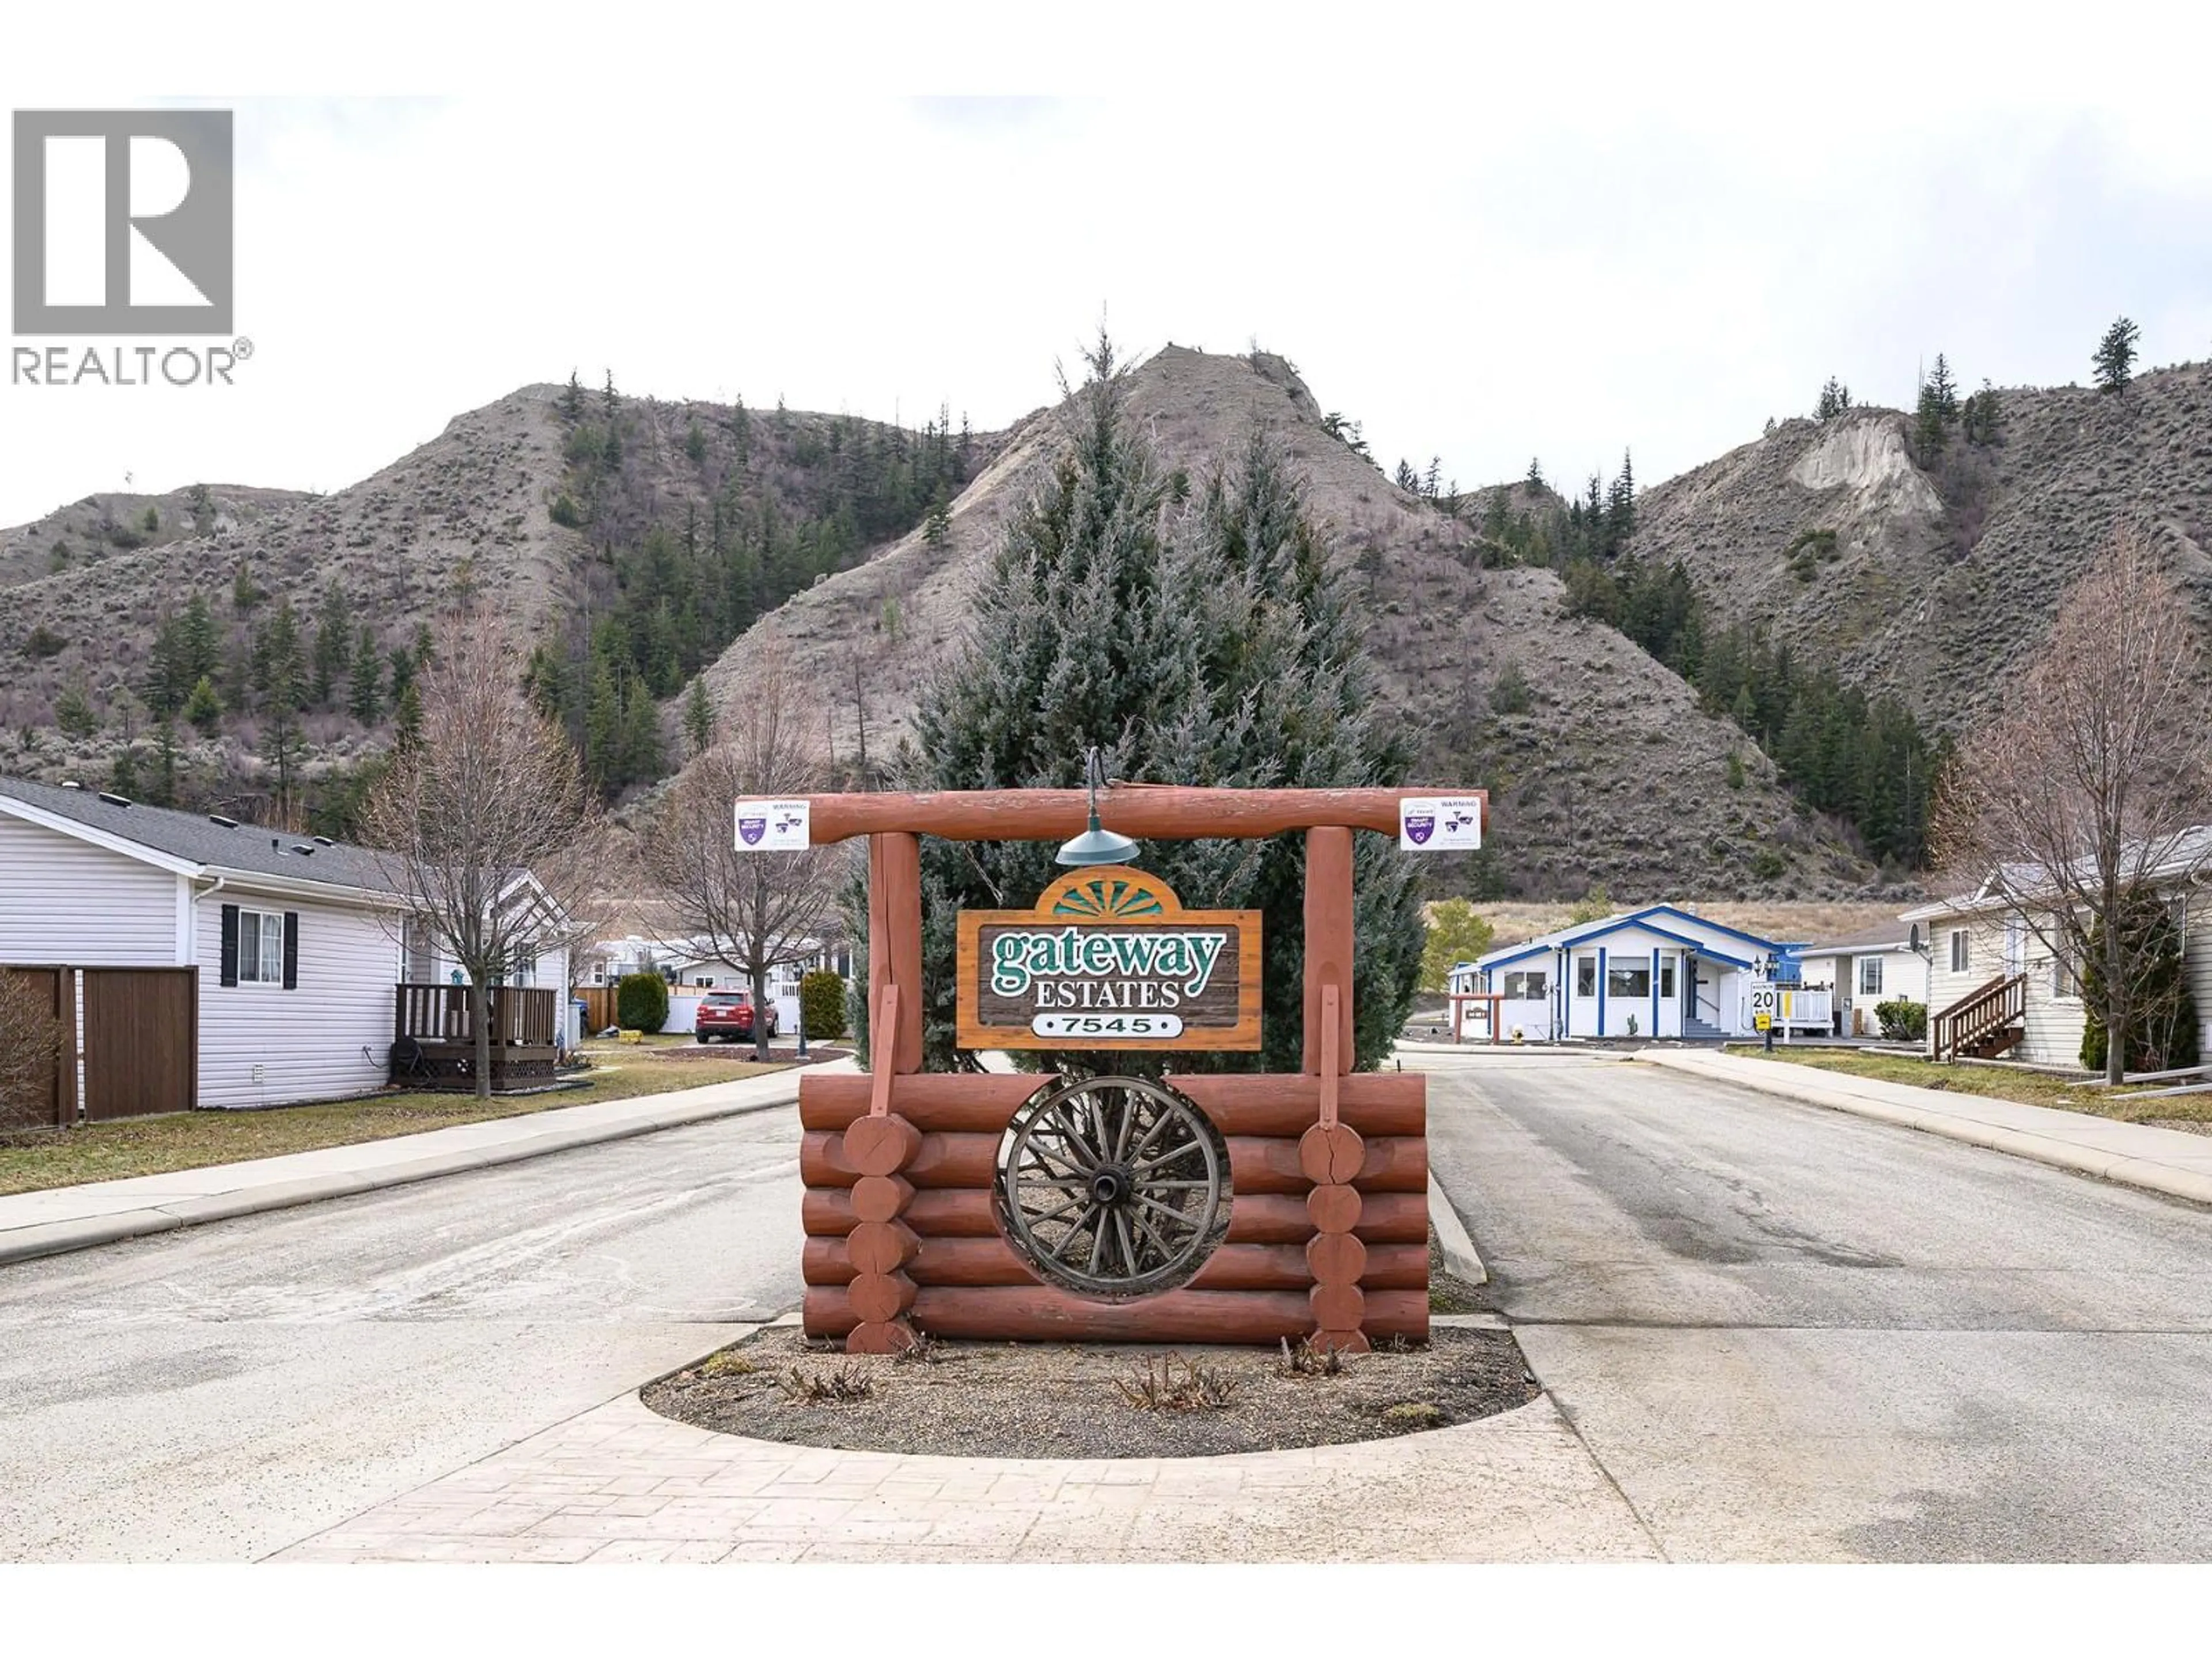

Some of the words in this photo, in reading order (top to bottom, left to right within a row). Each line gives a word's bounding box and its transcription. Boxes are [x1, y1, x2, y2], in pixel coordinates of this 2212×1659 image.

[991, 927, 1227, 997] gateway
[1035, 981, 1181, 1008] ESTATES
[1753, 991, 1774, 1007] 20
[1061, 1018, 1152, 1033] 7545
